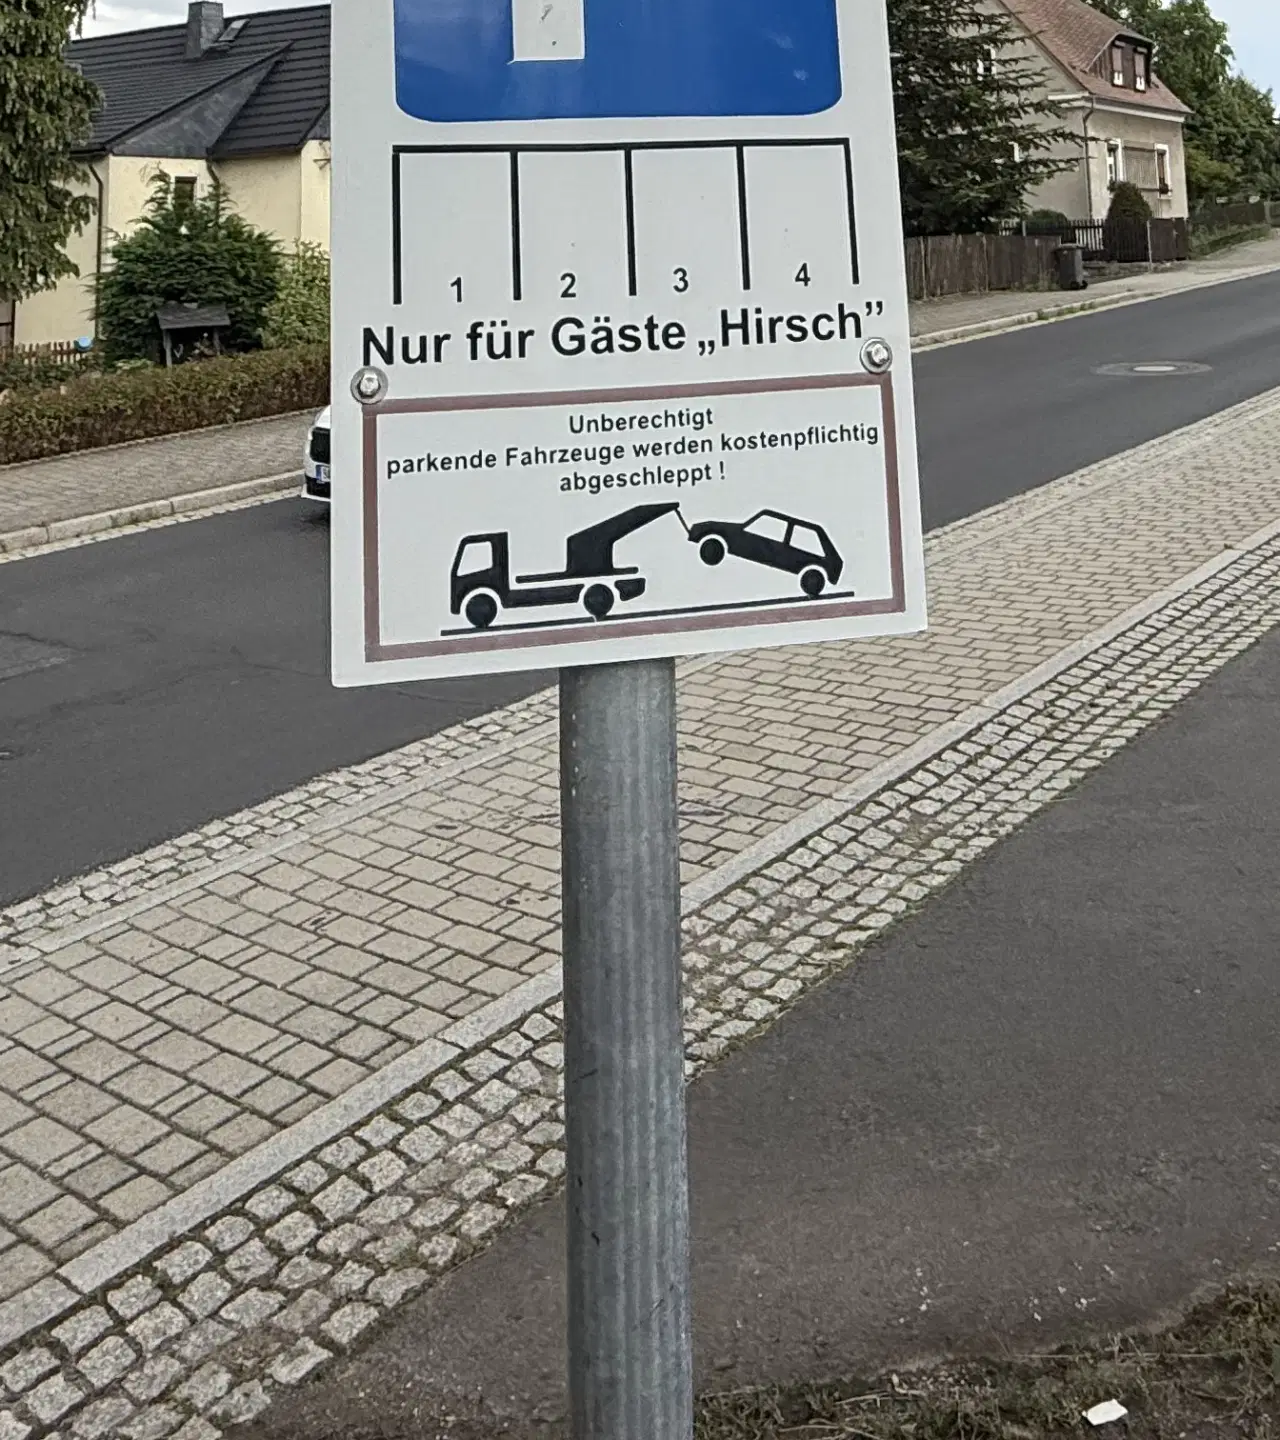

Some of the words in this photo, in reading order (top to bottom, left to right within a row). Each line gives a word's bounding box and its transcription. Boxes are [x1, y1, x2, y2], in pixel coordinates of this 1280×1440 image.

[450, 276, 463, 303] 1
[560, 272, 577, 299] 2
[673, 267, 689, 293] 3
[794, 262, 811, 287] 4
[362, 326, 452, 367] Nur
[466, 320, 535, 361] für
[551, 314, 686, 356] Gäste
[569, 407, 714, 434] Unberechtigt
[387, 449, 497, 480] parkende
[506, 441, 625, 466] Fahrzeuge
[632, 435, 713, 458] werden
[720, 422, 878, 454] kostenpflichtig
[559, 463, 712, 495] abgeschleppt
[719, 460, 725, 480] !
